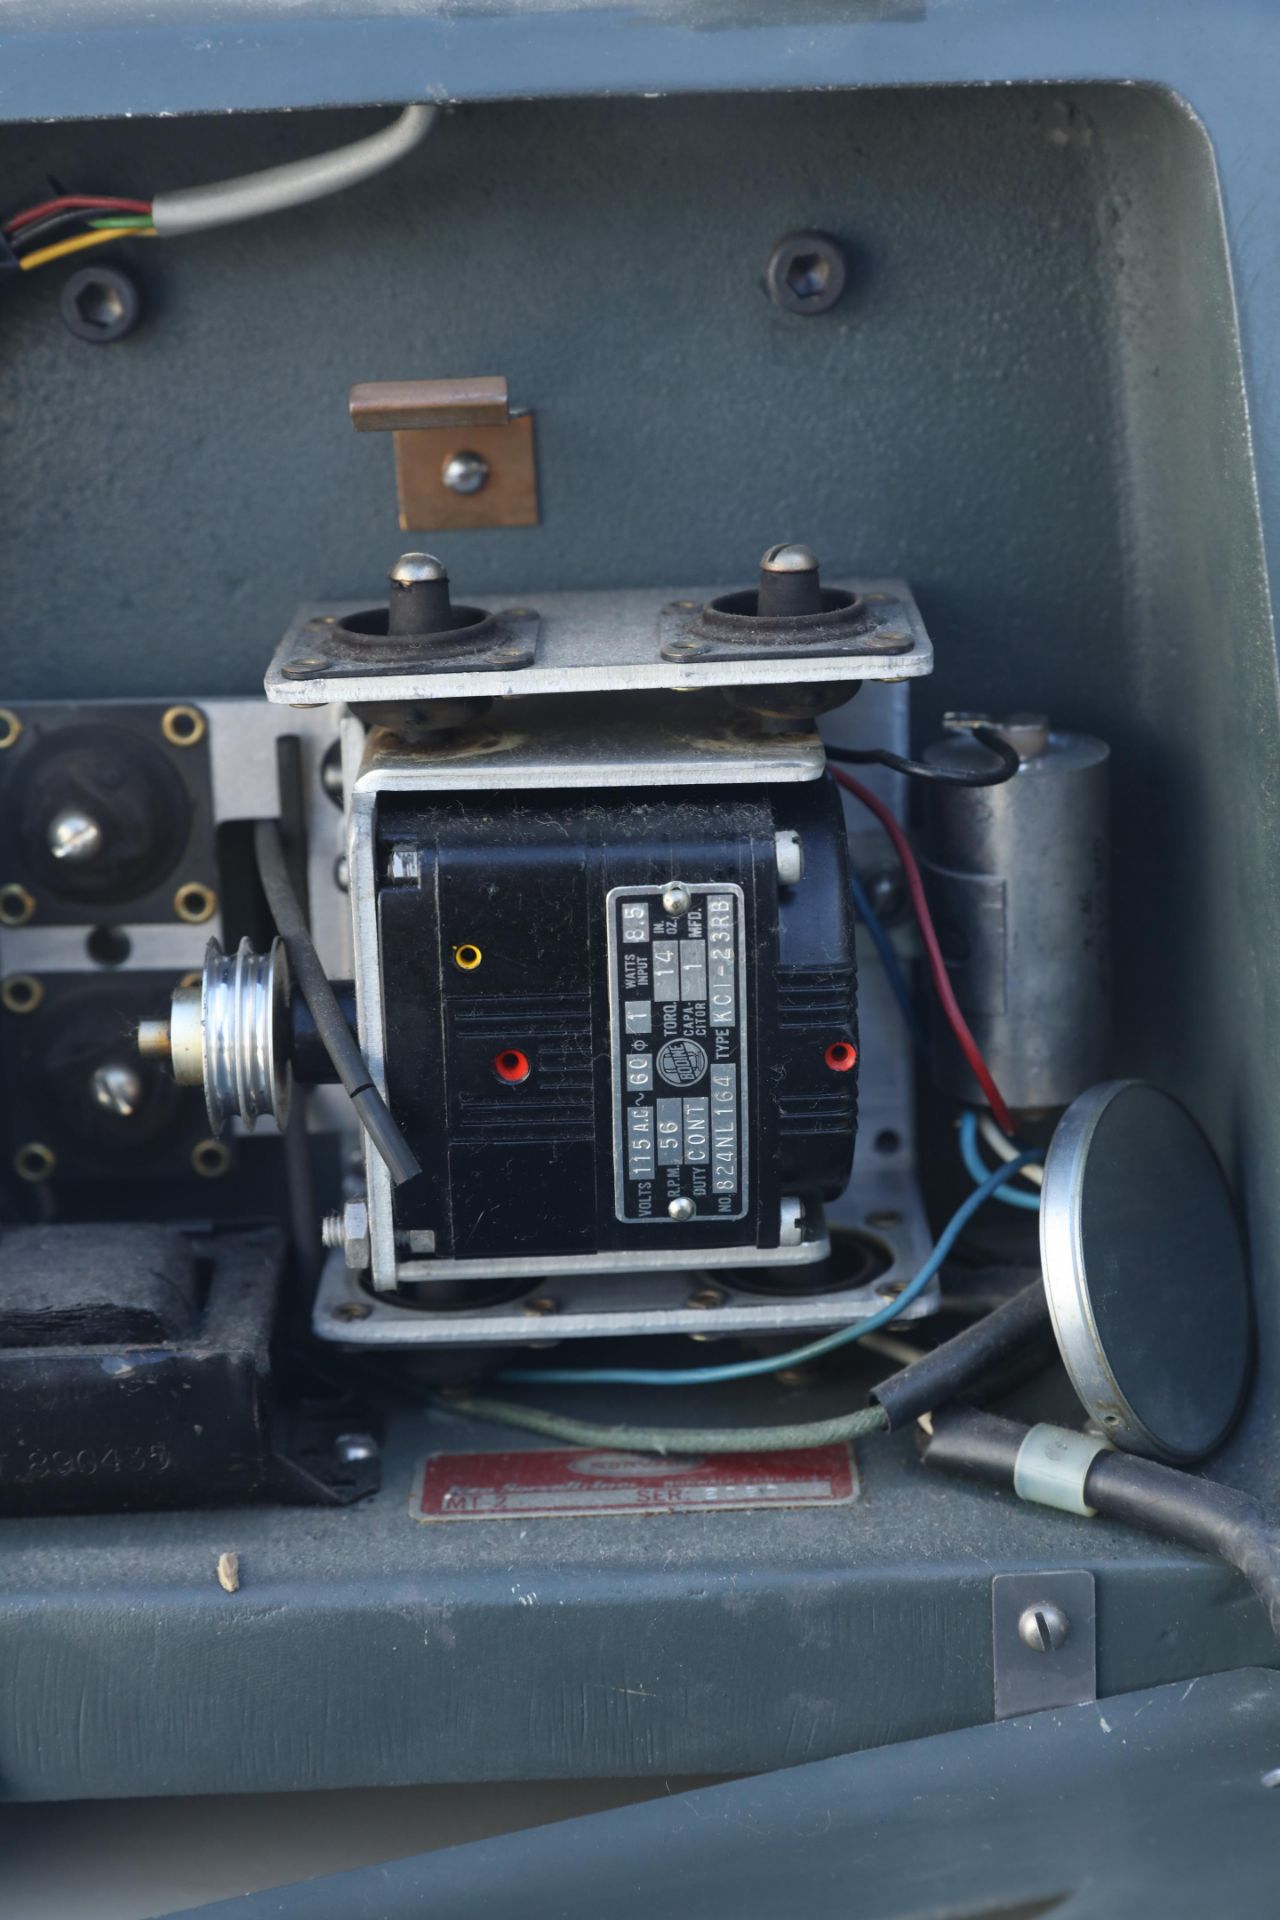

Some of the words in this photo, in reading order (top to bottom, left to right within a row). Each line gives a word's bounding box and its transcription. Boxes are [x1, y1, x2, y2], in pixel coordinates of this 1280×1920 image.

[625, 907, 644, 940] 8.5
[654, 921, 664, 933] IN.
[666, 919, 677, 934] OZ.
[688, 908, 701, 938] MFD.
[625, 954, 637, 989] WATTS
[637, 956, 648, 985] INPUT
[655, 951, 674, 976] 14
[663, 1002, 677, 1036] TORQ.
[683, 1002, 694, 1036] CAPA-
[695, 1003, 706, 1036] CITOR
[715, 1029, 729, 1060] TYPE
[668, 1043, 695, 1080] BODINE
[659, 1122, 678, 1148] 56
[713, 1076, 734, 1190] 824NL164
[633, 1139, 651, 1174] 115
[667, 1165, 680, 1197] R.P.M.
[693, 1168, 706, 1195] DUTY
[638, 1182, 651, 1216] VOLTS
[718, 1194, 732, 1212] NO.
